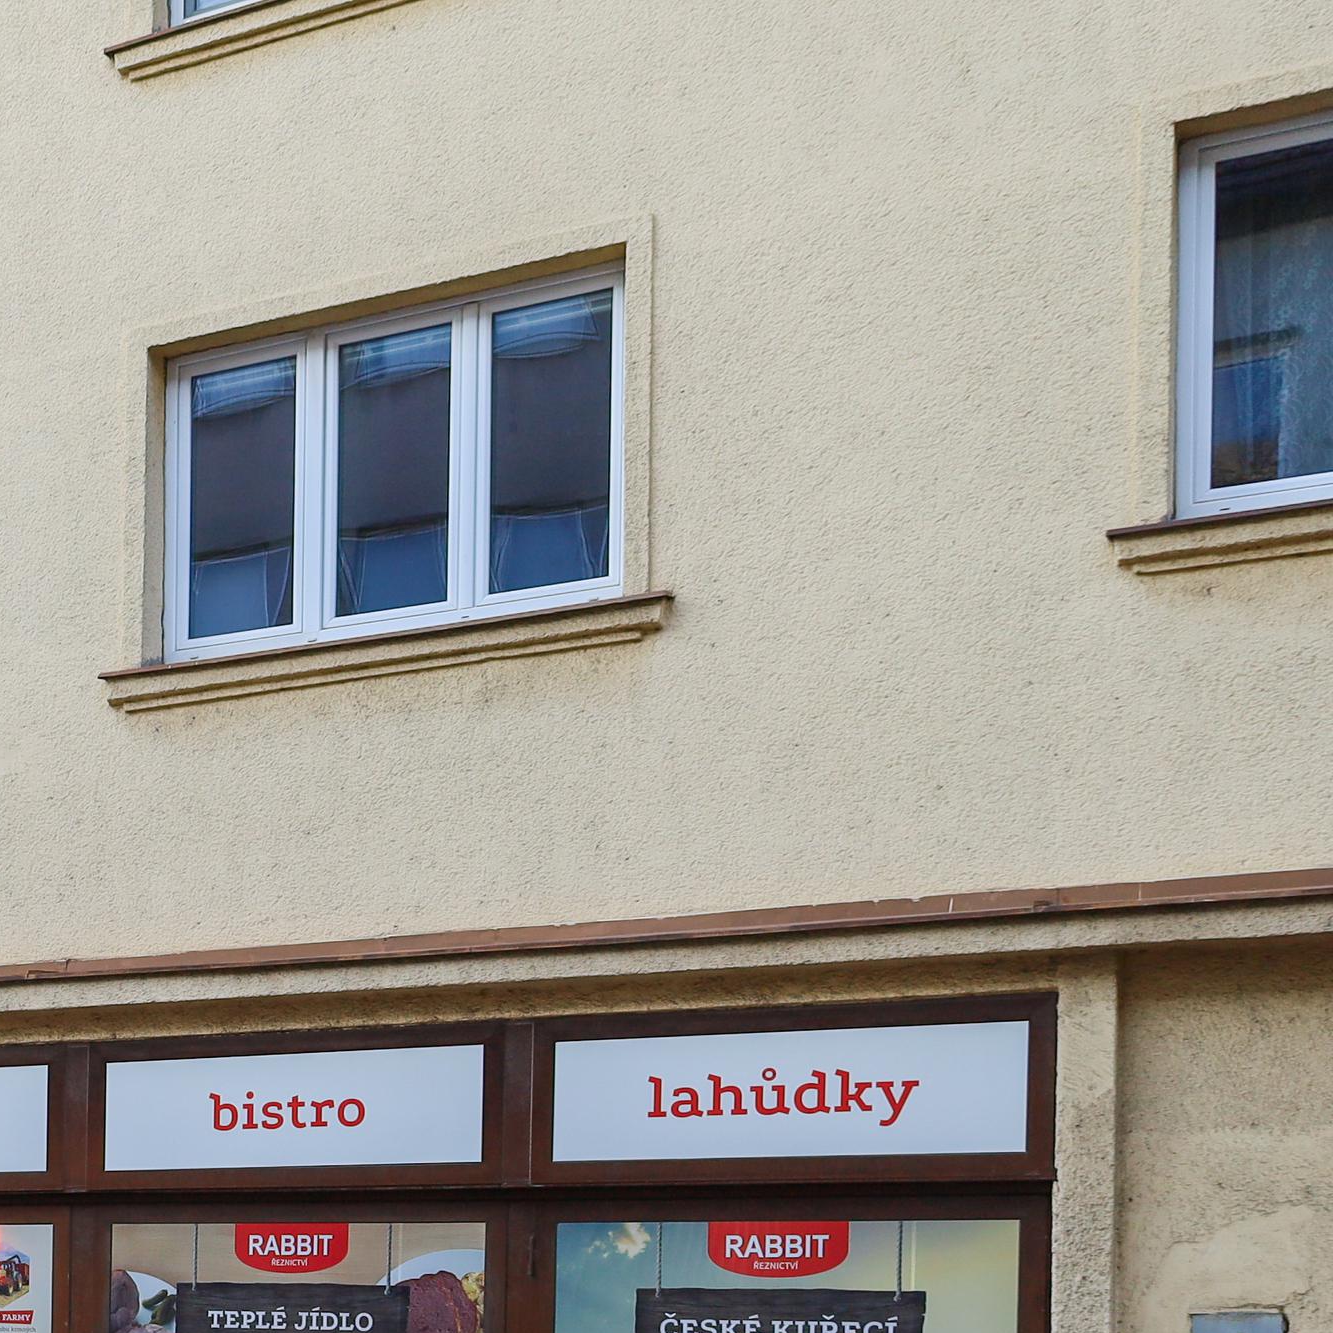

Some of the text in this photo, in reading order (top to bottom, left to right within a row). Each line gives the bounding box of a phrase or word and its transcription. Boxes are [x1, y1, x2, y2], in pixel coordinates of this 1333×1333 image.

[647, 1067, 919, 1127] lahůdky
[209, 1091, 366, 1131] bistro
[248, 1234, 333, 1255] RABBIT
[725, 1234, 829, 1258] RABBIT
[271, 1258, 308, 1266] ŘEZNICTVÍ
[753, 1261, 798, 1270] ŘEZNICTVÍ
[208, 1307, 373, 1332] TEPLÉ JÍDLO
